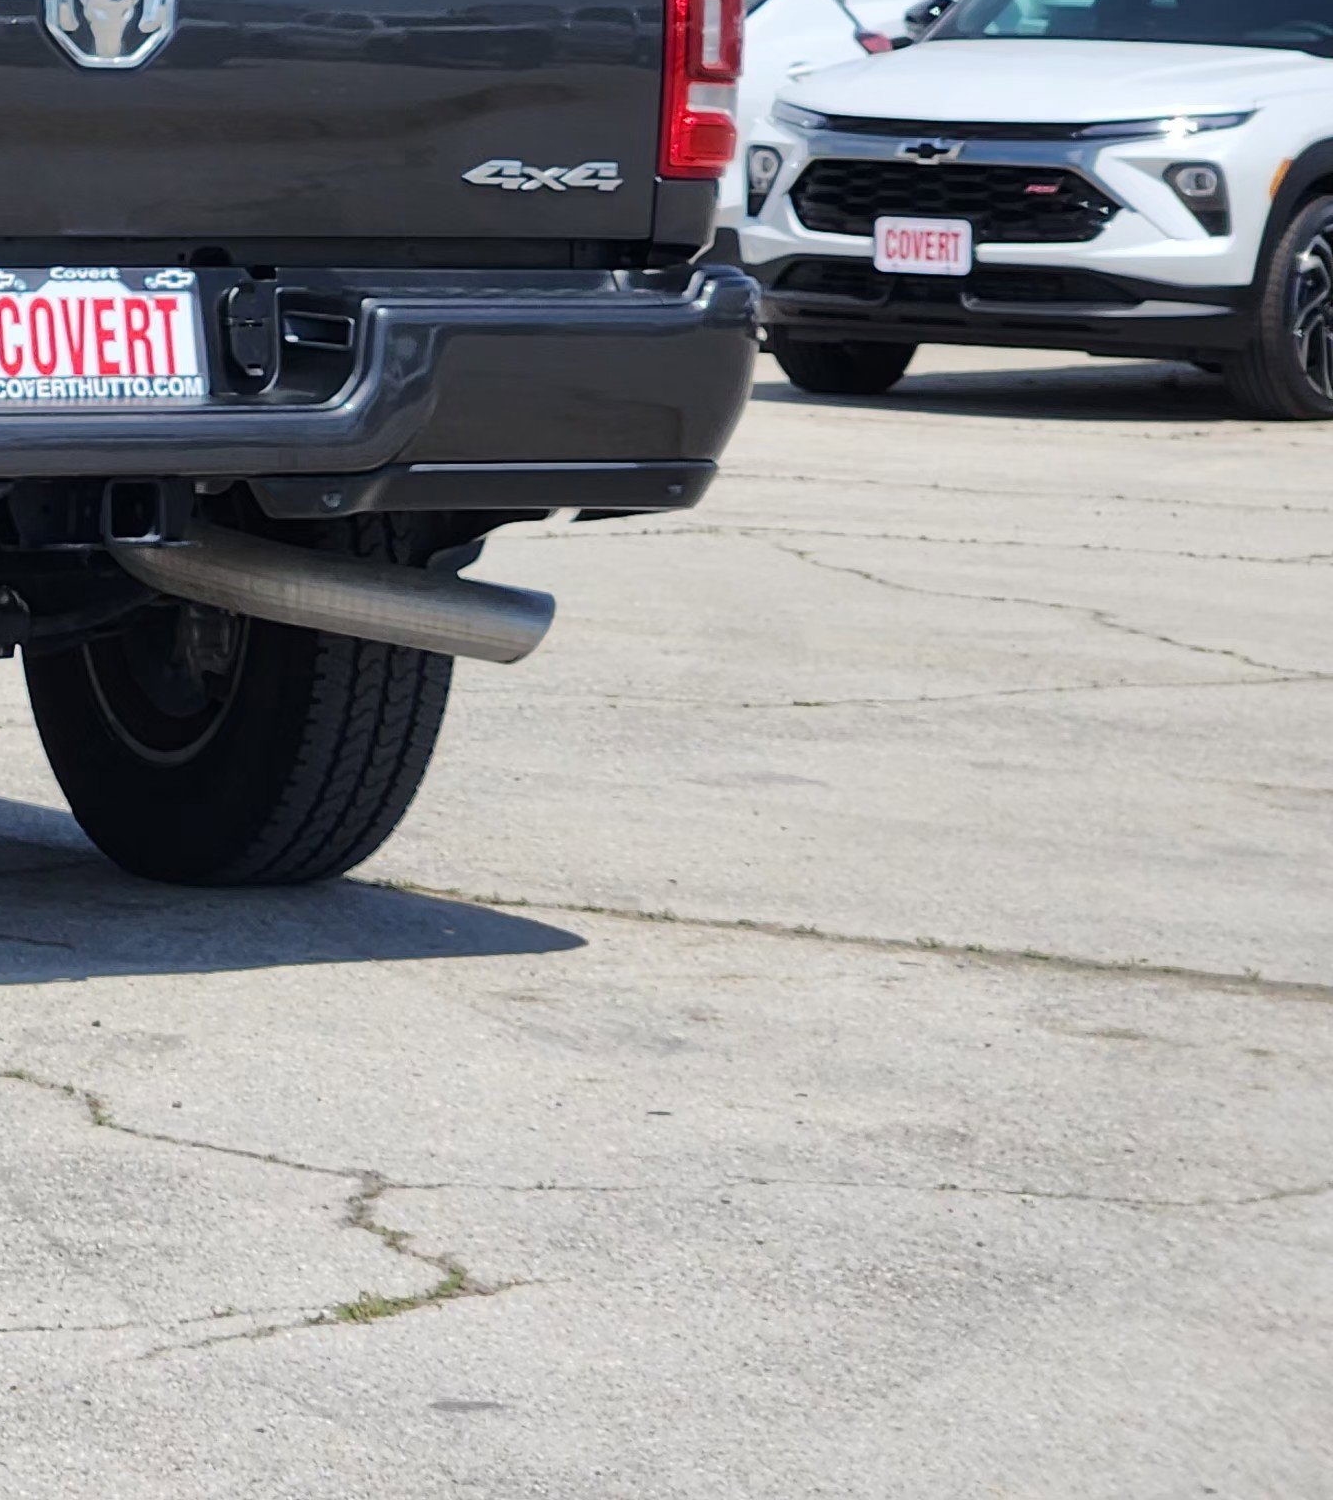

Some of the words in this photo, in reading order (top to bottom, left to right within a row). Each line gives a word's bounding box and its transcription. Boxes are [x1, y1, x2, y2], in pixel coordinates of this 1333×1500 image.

[461, 159, 624, 192] 4x4
[885, 229, 962, 263] COVERT
[49, 266, 121, 281] Covert
